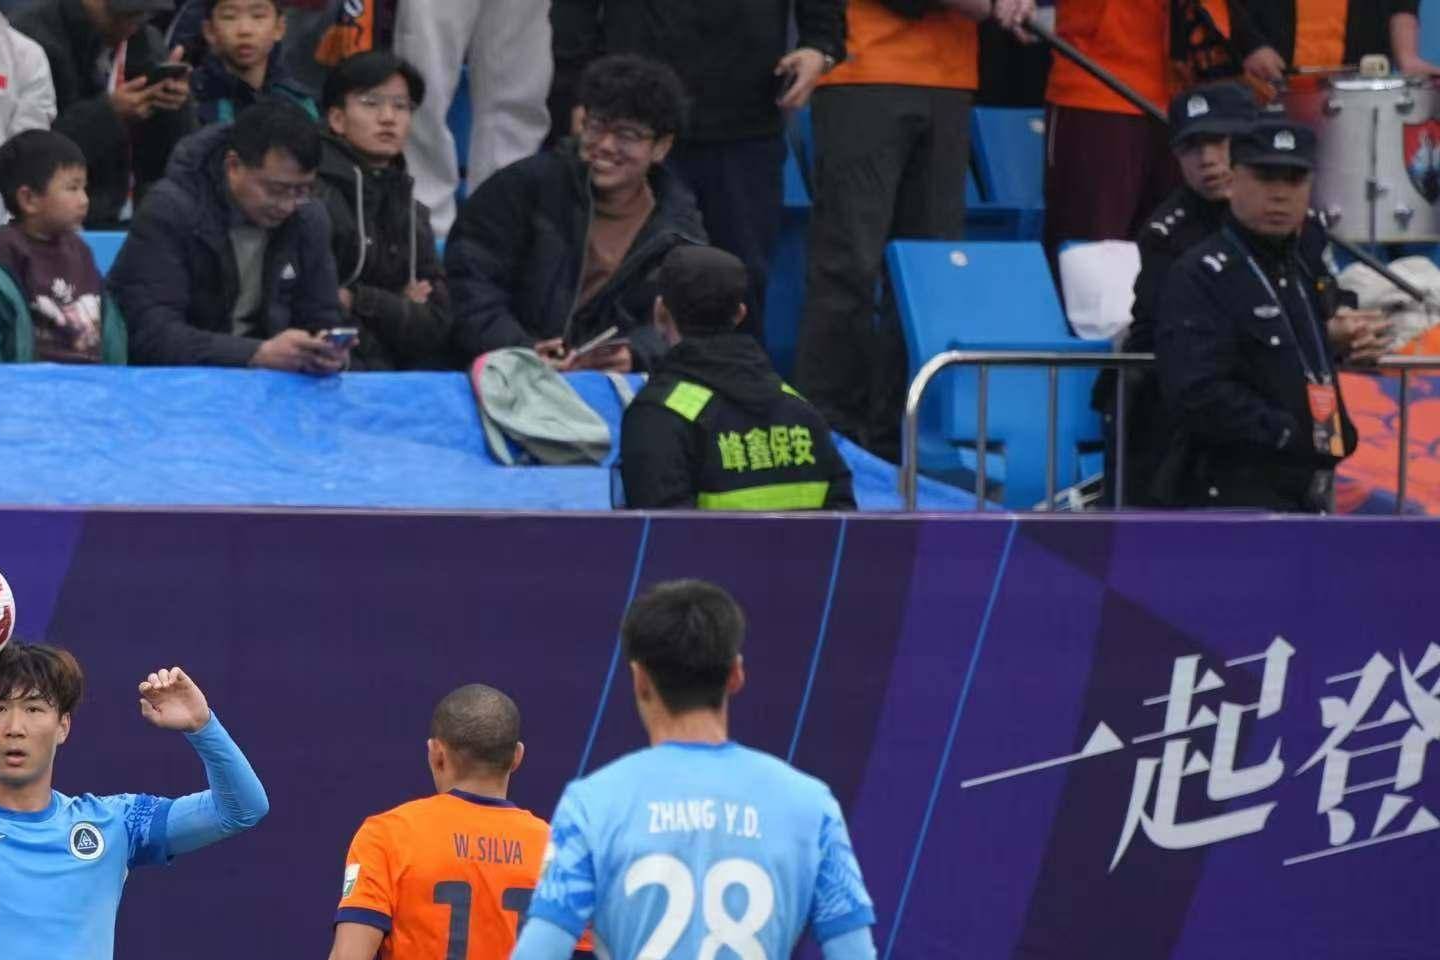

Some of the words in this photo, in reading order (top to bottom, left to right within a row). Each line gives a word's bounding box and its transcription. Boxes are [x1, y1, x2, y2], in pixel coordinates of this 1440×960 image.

[648, 799, 716, 833] ZHANG
[724, 803, 762, 838] Y.D.
[961, 635, 1440, 873] 一起登
